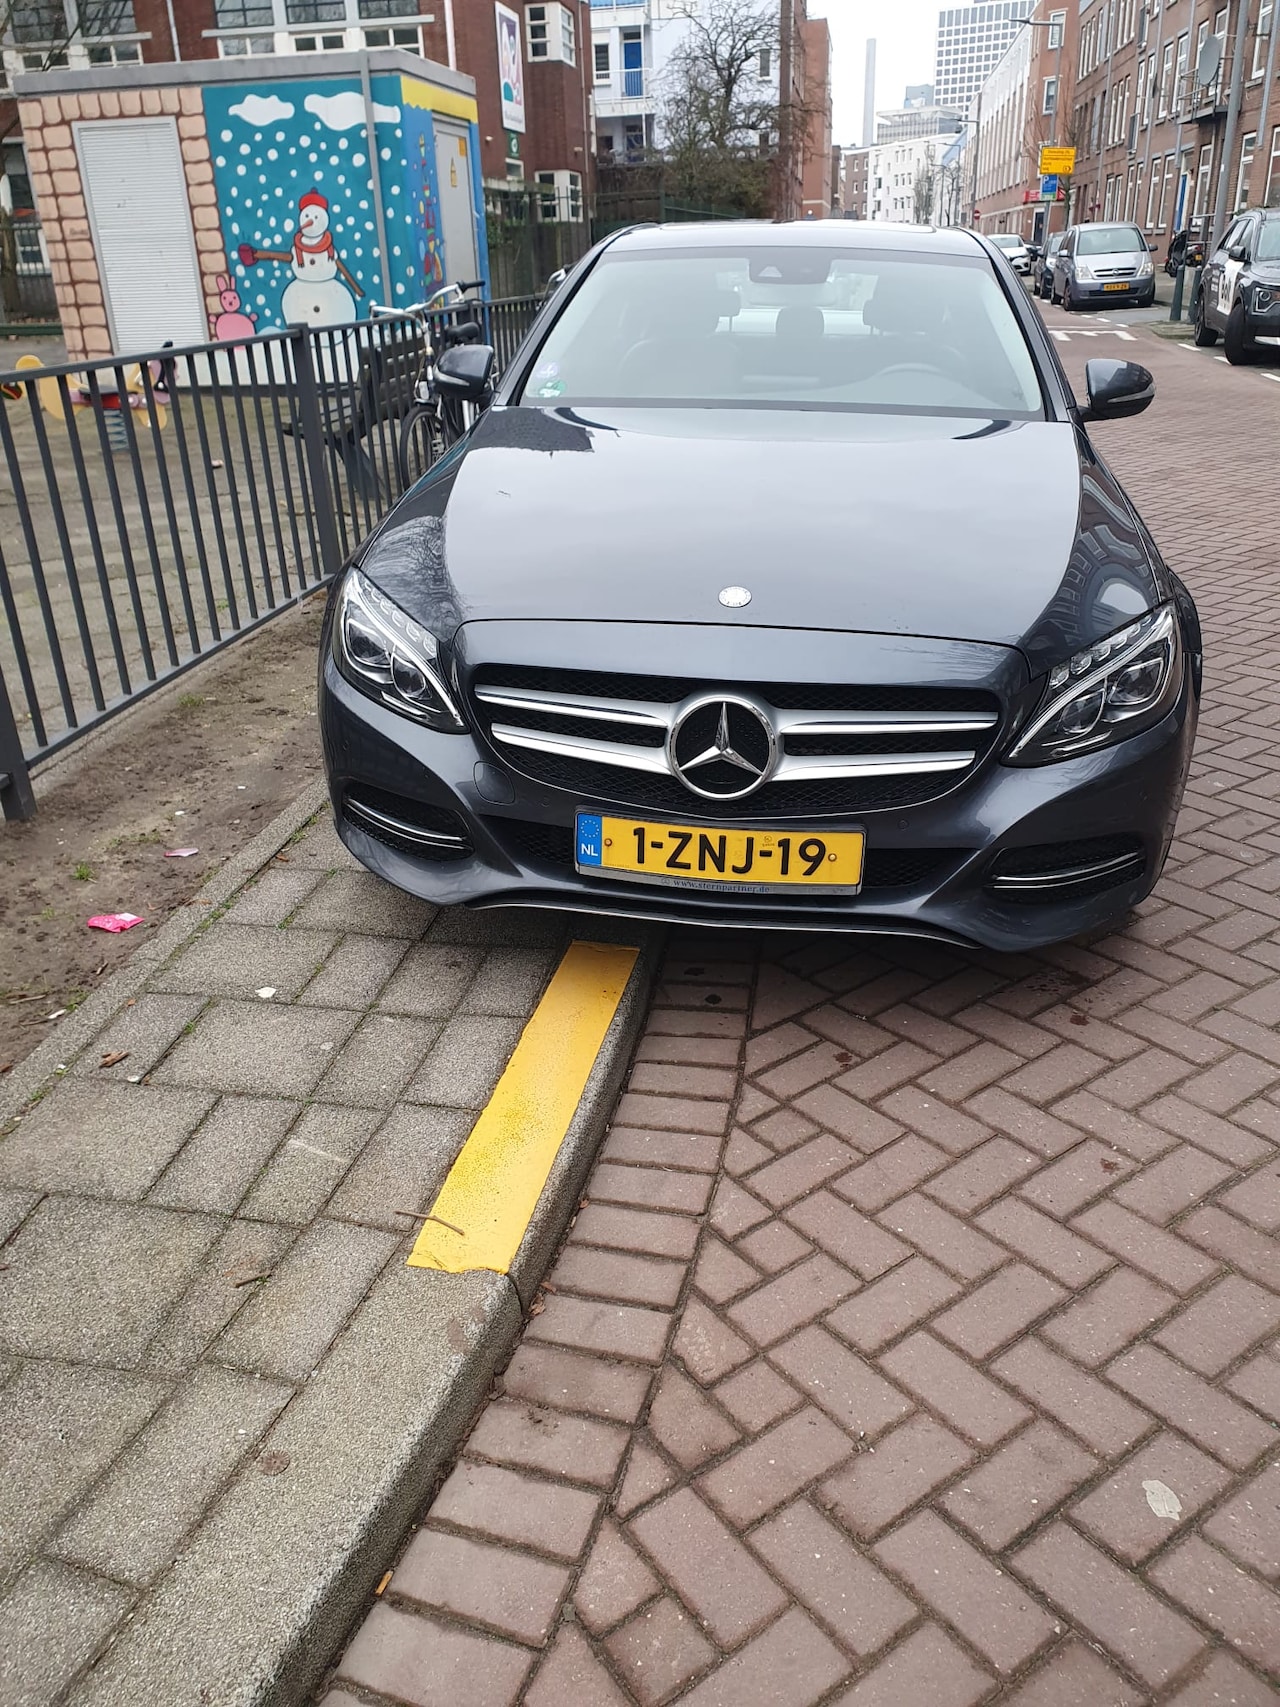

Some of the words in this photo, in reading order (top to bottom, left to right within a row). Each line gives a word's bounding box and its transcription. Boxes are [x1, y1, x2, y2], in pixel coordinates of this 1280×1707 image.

[581, 842, 599, 858] NL
[633, 827, 826, 876] 1-ZNJ-19
[673, 880, 770, 894] www.sternpartner.de
